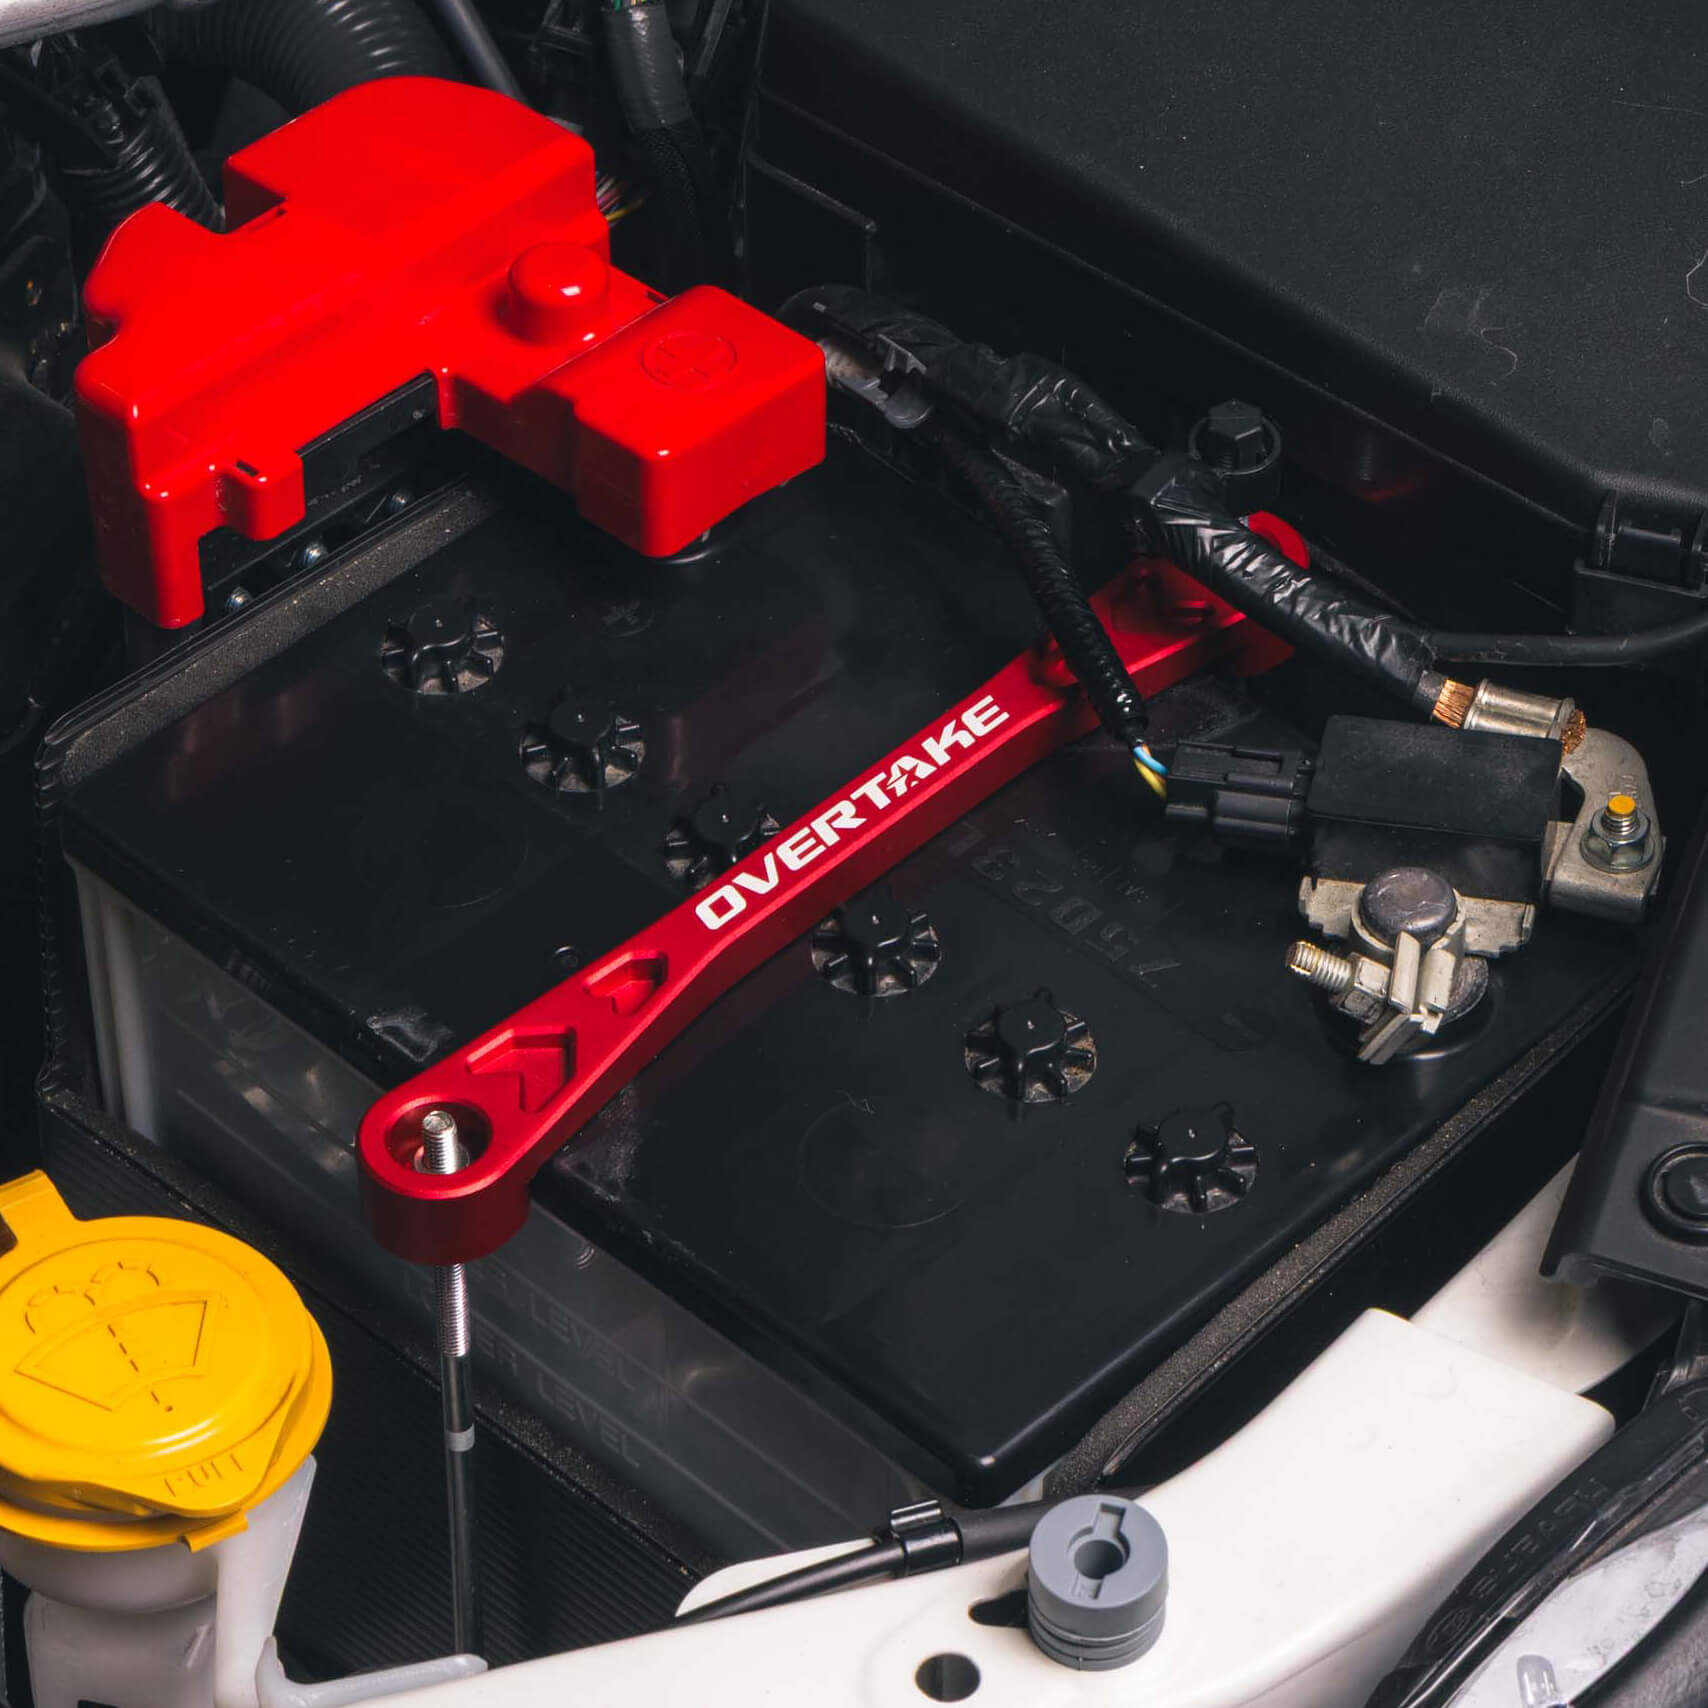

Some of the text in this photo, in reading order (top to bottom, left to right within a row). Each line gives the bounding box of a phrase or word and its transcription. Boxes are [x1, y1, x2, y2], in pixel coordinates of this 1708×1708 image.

[695, 694, 1010, 930] OVERTAKE
[530, 1292, 637, 1392] LEVEL
[537, 1371, 641, 1469] LEVEL
